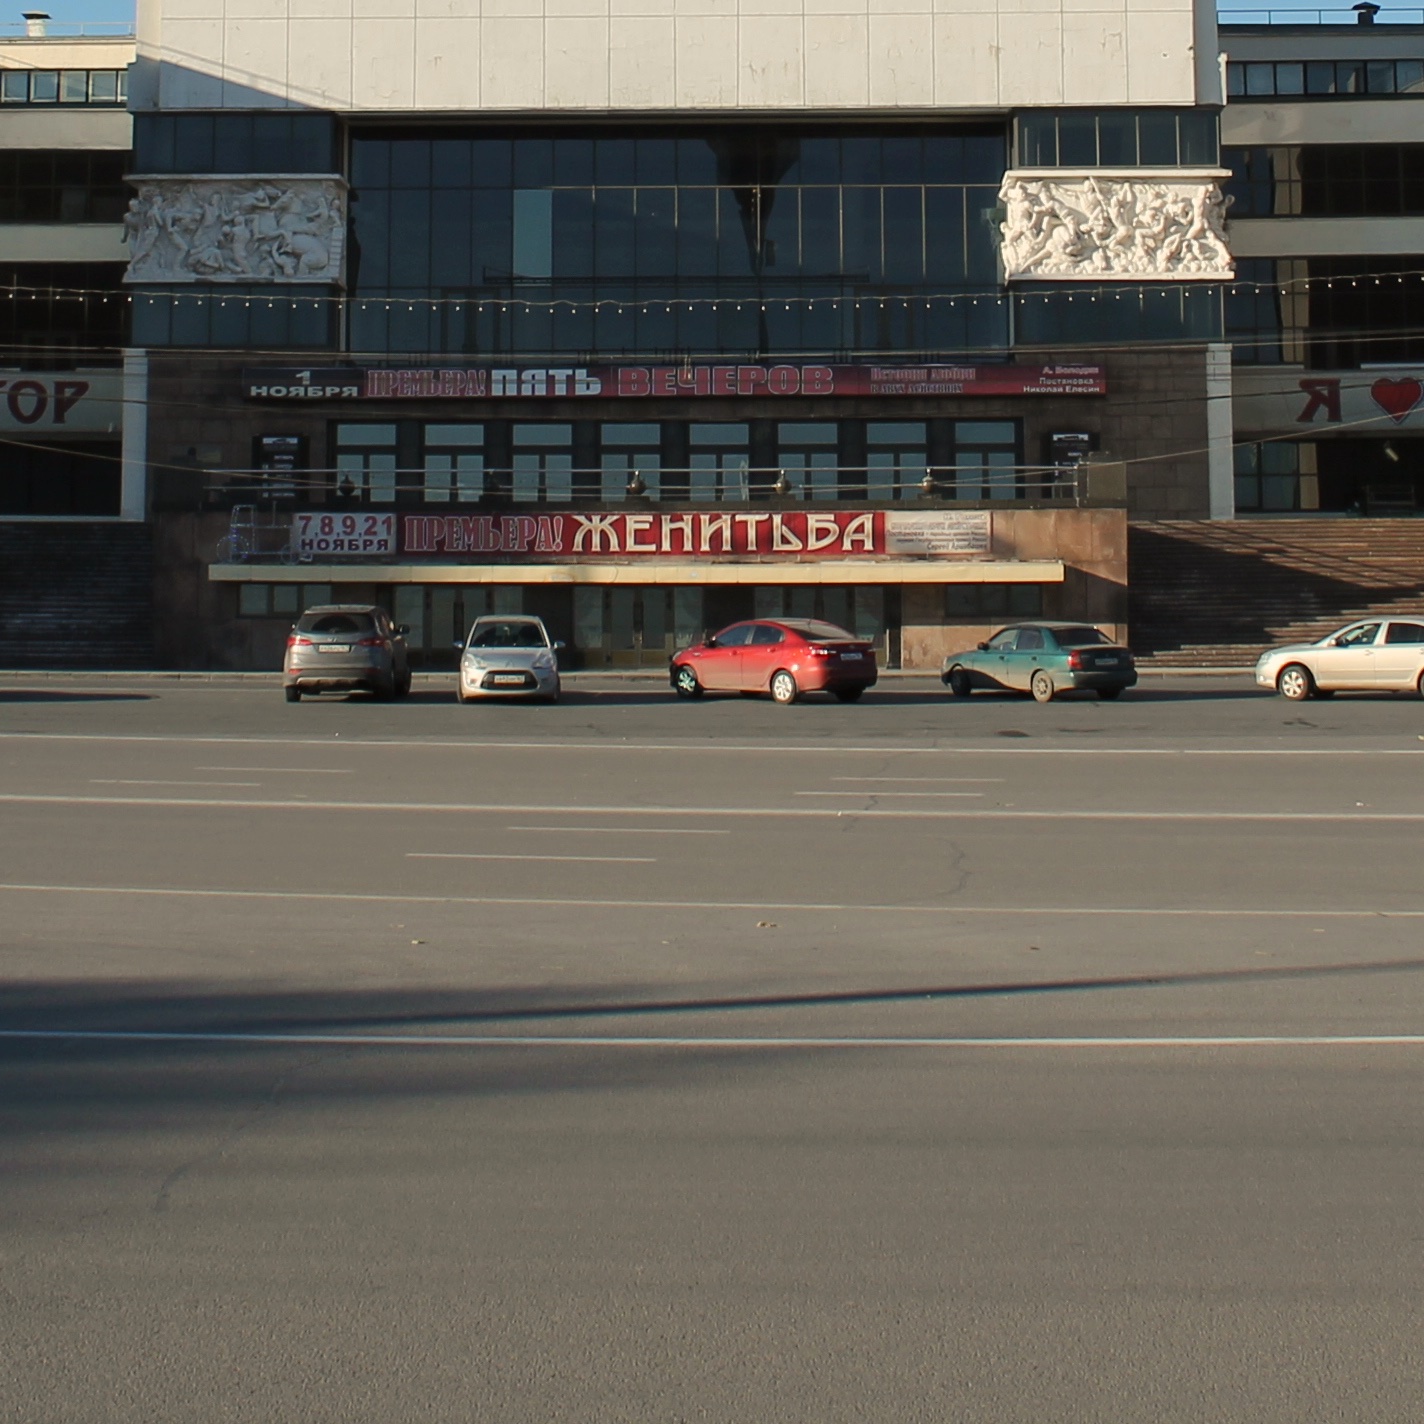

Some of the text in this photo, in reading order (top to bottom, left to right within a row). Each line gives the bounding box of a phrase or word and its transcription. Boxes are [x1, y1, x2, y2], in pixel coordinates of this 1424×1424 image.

[295, 370, 311, 385] 1
[367, 365, 834, 396] ПРЕМЬЕРА! ПЯТЬ ВЕЧЕРОВ
[249, 385, 358, 398] НОЯБРЯ
[1296, 377, 1343, 423] Я
[301, 538, 389, 551] НОЯБРЯ
[404, 513, 875, 553] ПРЕМЬЕРА! ЖЕНИТЬБА
